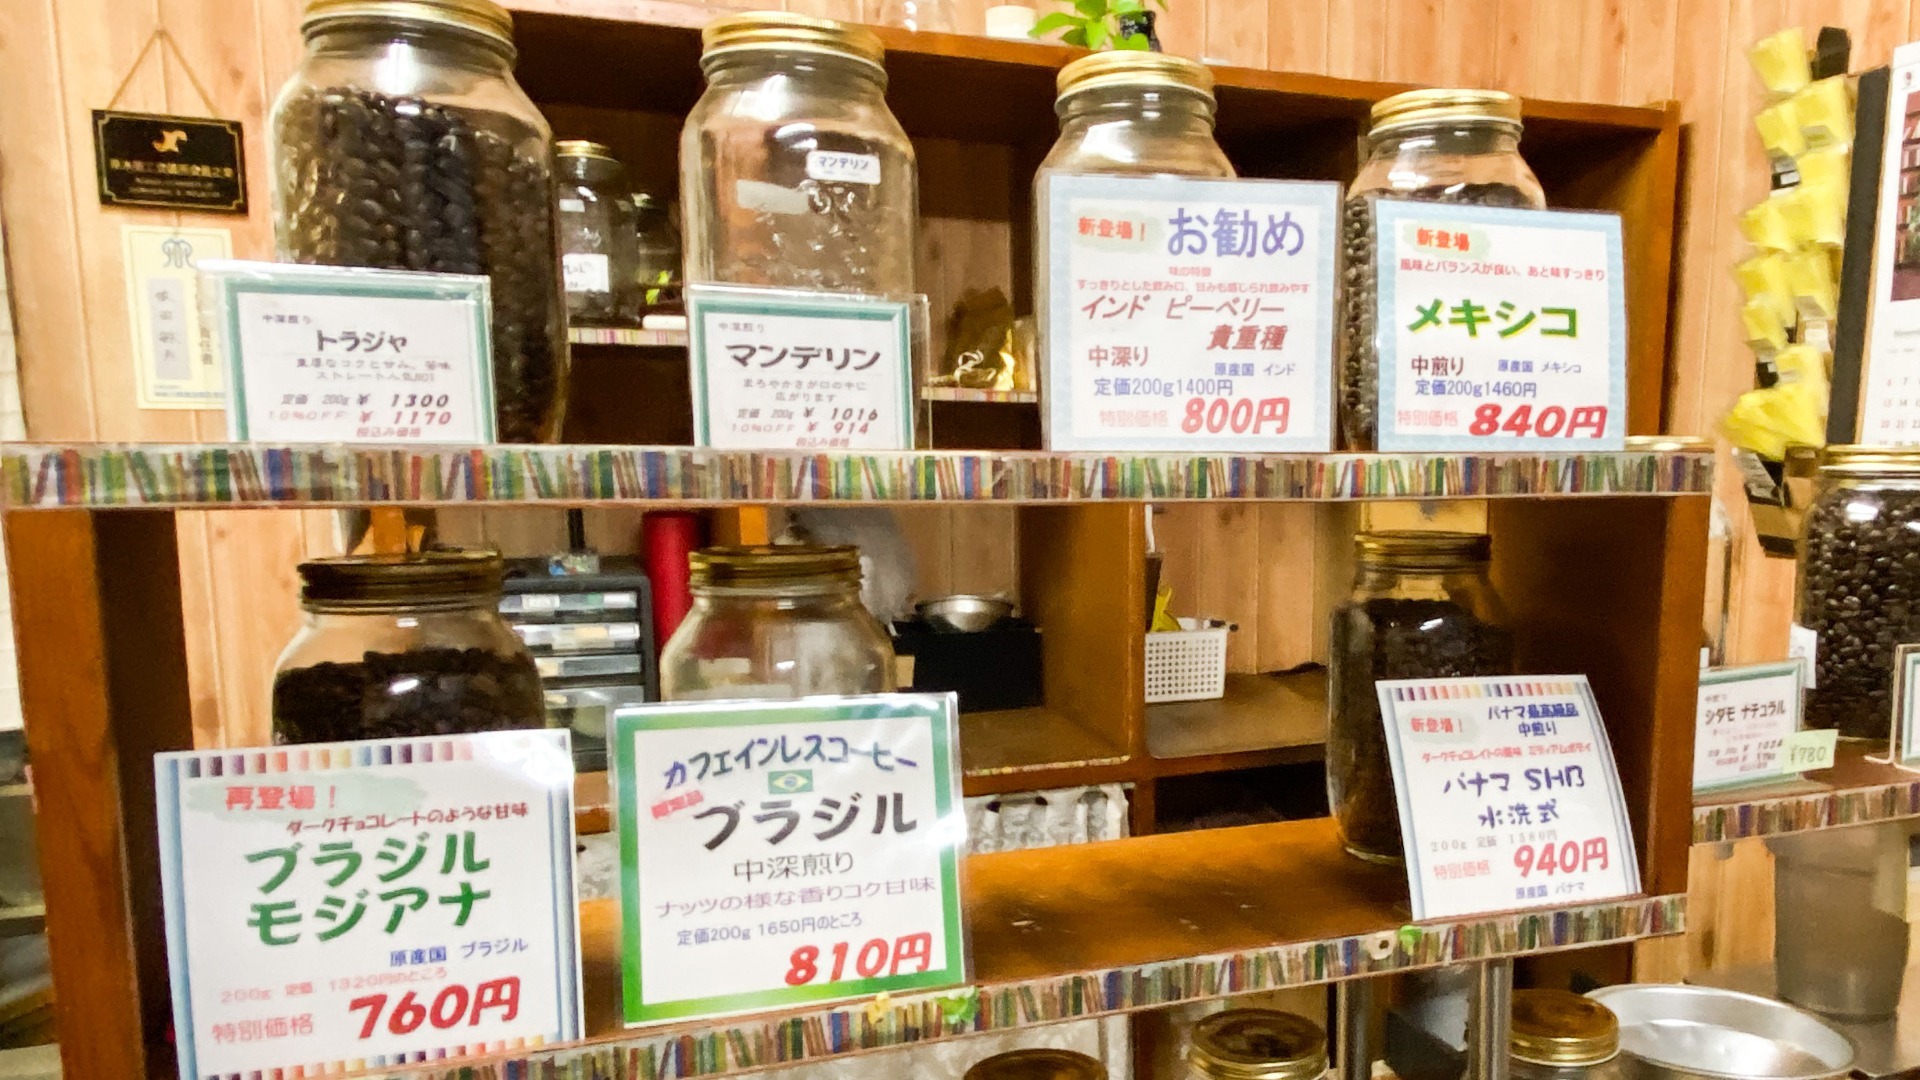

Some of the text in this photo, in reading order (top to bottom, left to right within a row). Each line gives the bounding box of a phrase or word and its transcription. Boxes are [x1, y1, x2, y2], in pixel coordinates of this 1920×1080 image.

[1168, 208, 1305, 258] お勧め
[1417, 228, 1470, 252] 新登場
[1081, 295, 1151, 320] インド
[1406, 298, 1579, 338] メキシコ
[1206, 324, 1288, 350] 貴重種
[725, 344, 881, 371] マンデリン
[1088, 346, 1148, 367] 中深り
[1214, 362, 1296, 376] 原産国 インド
[1411, 356, 1464, 376] 中煎り
[1498, 360, 1582, 374] 原産国 メキシコ
[1094, 378, 1233, 397] 定価200g1400円
[1415, 380, 1537, 398] 定価200g1460円
[391, 394, 449, 408] 1300
[394, 411, 451, 425] 1170
[831, 408, 878, 421] 1016
[1099, 396, 1291, 434] 特別価格 800円
[1398, 403, 1608, 439] 特別価格 840円
[834, 422, 870, 435] 914
[1705, 706, 1735, 725] シダモ
[663, 734, 918, 790] カフェインレスコーヒー
[1524, 765, 1584, 790] SHB
[694, 792, 918, 851] ブラジル
[1478, 798, 1559, 828] 水洗式
[1430, 840, 1467, 852] 200g
[1476, 836, 1497, 848] 定価
[244, 830, 490, 894] ブラジル
[734, 852, 854, 882] 中深煎り
[1433, 836, 1608, 880] 特別価格 940円
[656, 876, 936, 918] ナッツの様な香りコク甘味
[1516, 884, 1548, 900] 原産国
[247, 881, 491, 946] モジアナ
[676, 912, 862, 946] 定価200g 1650円のところ
[390, 938, 528, 967] 原産国 ブラジル
[784, 932, 932, 986] 810円
[211, 976, 520, 1045] 特別価格 760円
